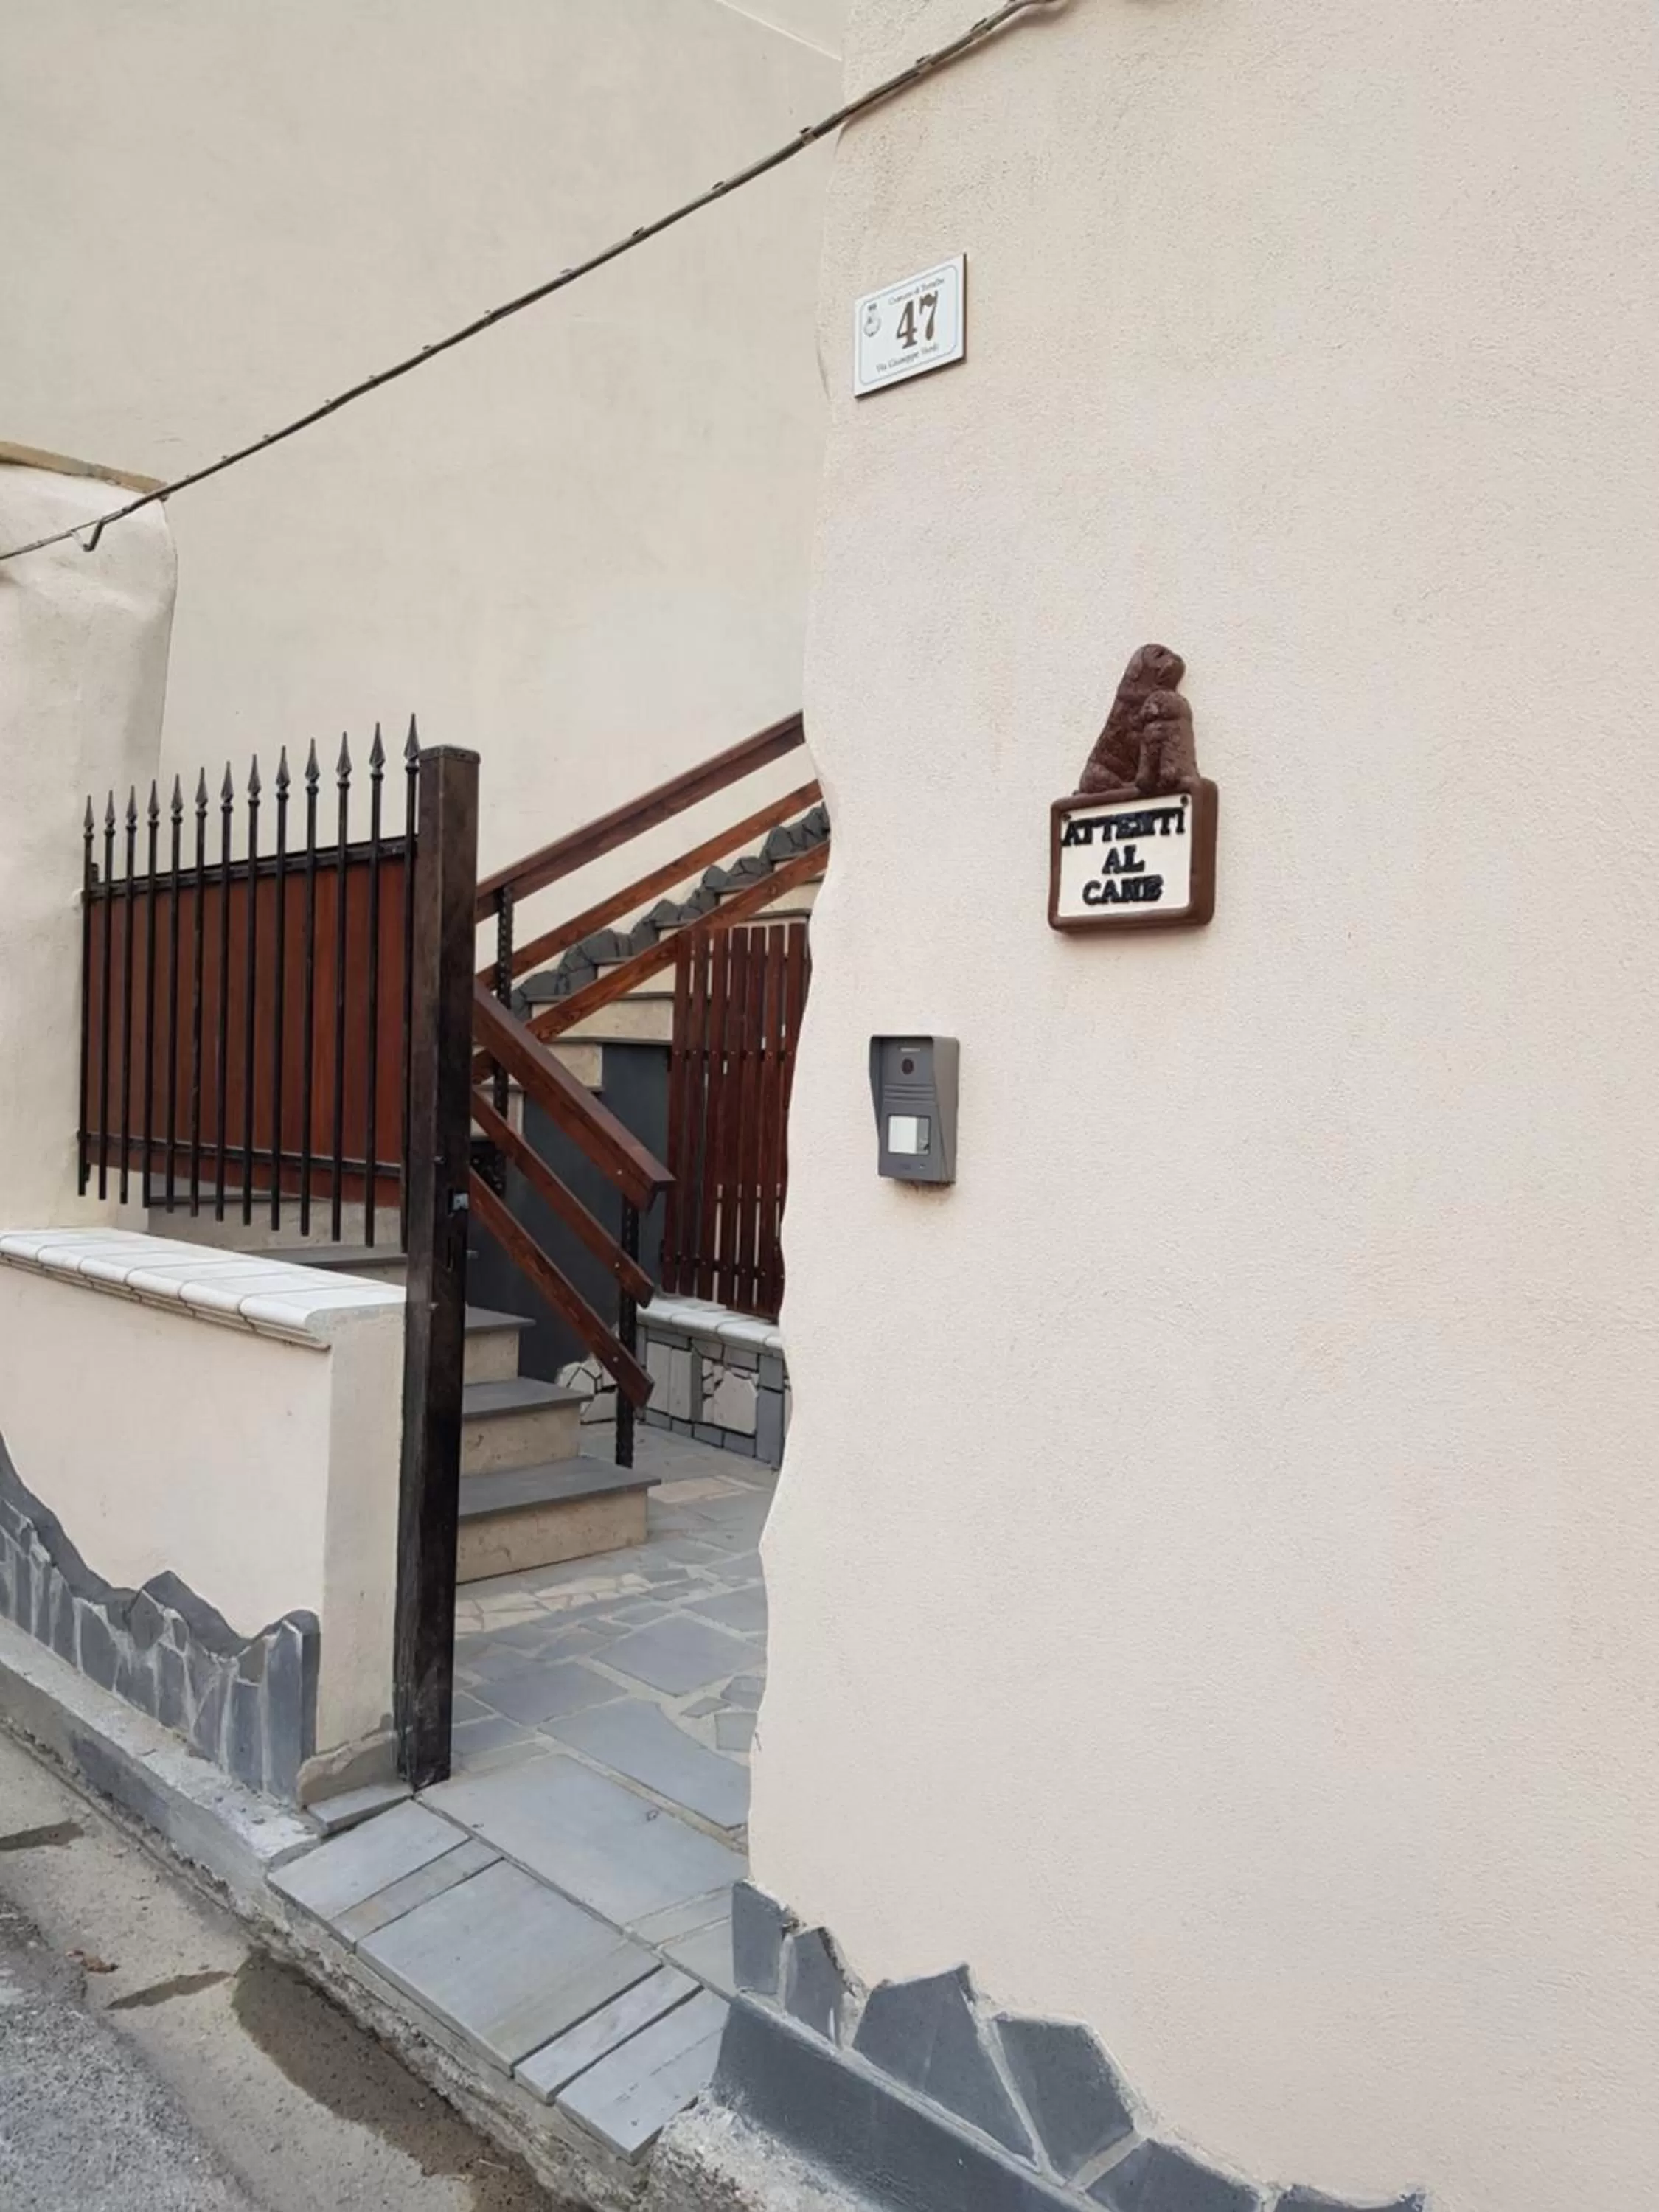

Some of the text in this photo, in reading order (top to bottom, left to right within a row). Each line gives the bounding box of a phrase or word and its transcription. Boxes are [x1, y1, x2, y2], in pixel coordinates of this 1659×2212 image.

[896, 290, 938, 349] 47
[1061, 807, 1186, 847] ATTENTI
[1102, 844, 1145, 875] AL
[1082, 874, 1164, 906] CANE
